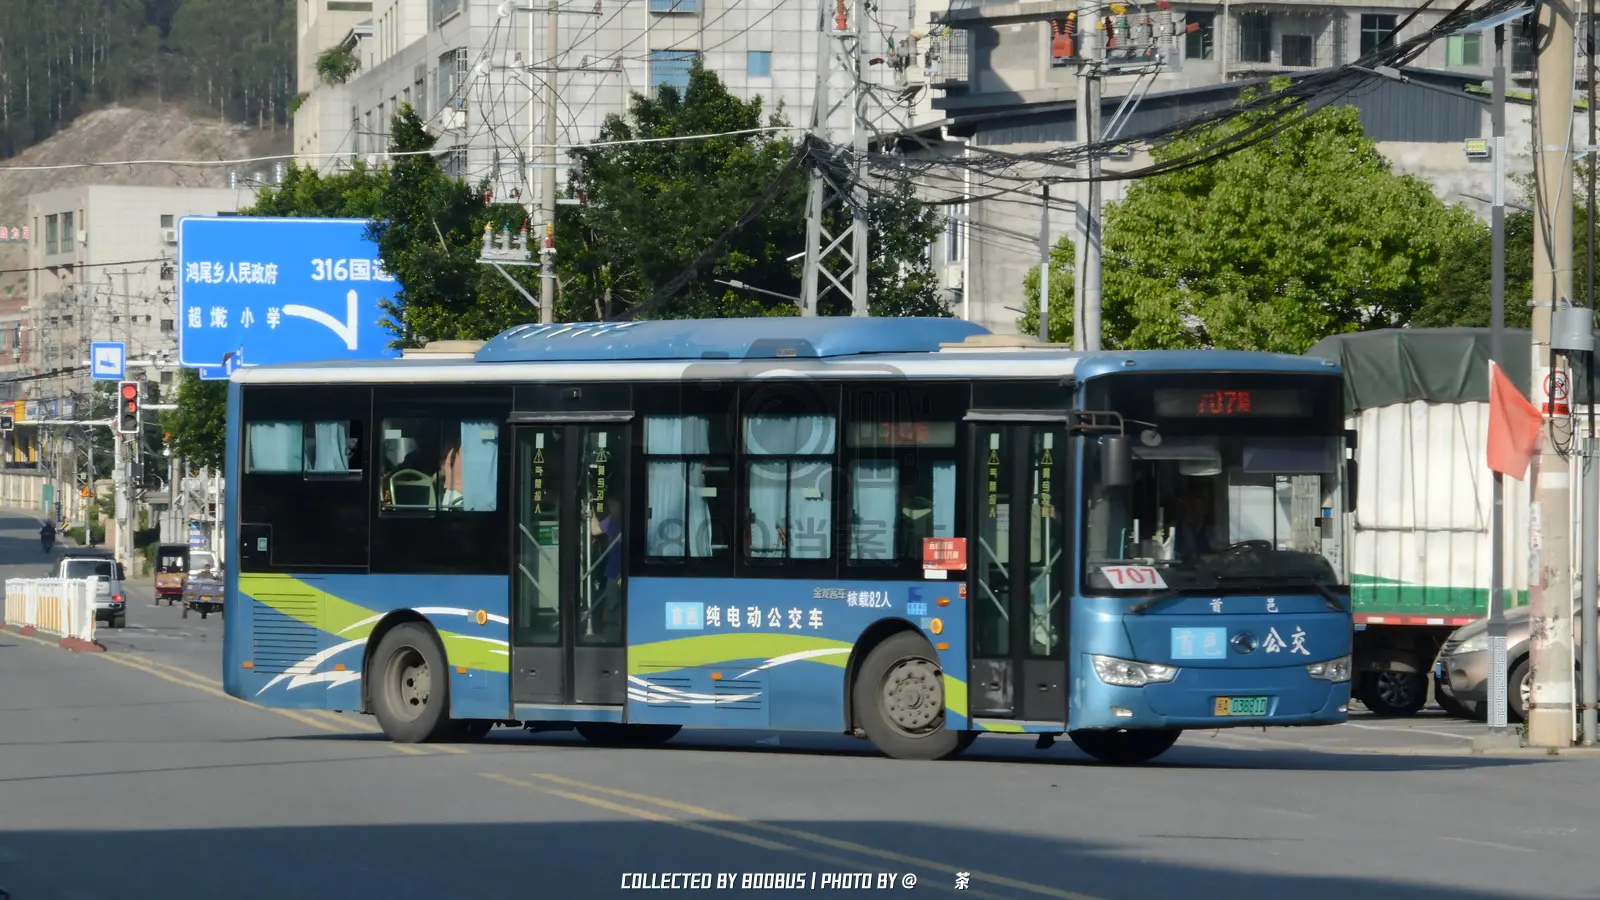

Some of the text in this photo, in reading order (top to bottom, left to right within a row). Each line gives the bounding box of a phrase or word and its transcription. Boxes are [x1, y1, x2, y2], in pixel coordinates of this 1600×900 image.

[186, 261, 278, 284] 鸿尾乡人民政府
[1107, 568, 1156, 584] 707
[813, 587, 847, 600] 金龙客车
[847, 591, 892, 608] 核载82人
[706, 604, 824, 630] 纯电动公交车
[1262, 626, 1311, 656] 公交
